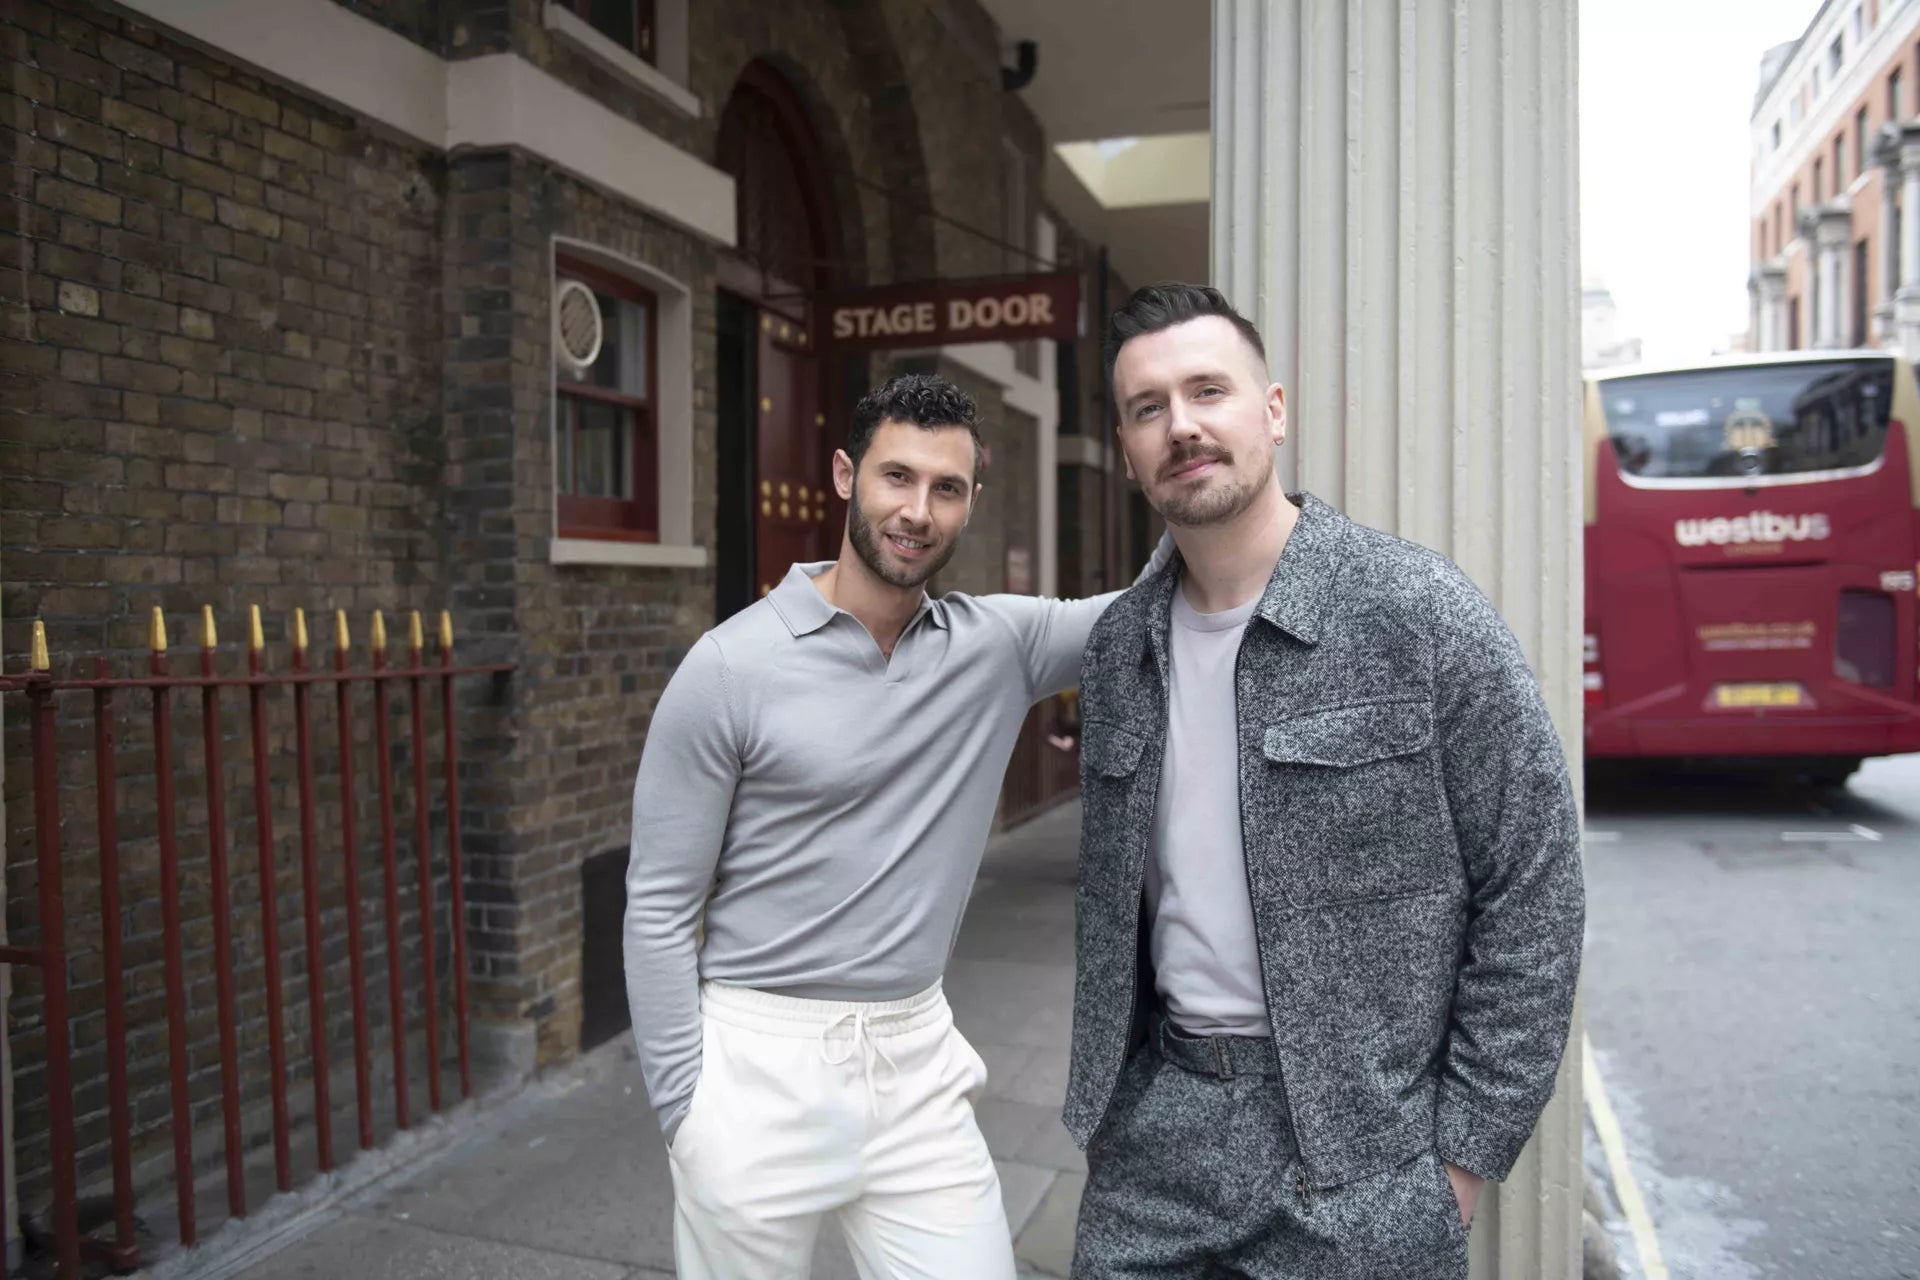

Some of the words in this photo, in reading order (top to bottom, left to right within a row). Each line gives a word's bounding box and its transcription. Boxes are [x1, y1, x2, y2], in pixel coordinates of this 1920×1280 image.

[833, 303, 936, 338] STAGE
[949, 294, 1055, 330] DOOR
[1675, 511, 1830, 546] westbus
